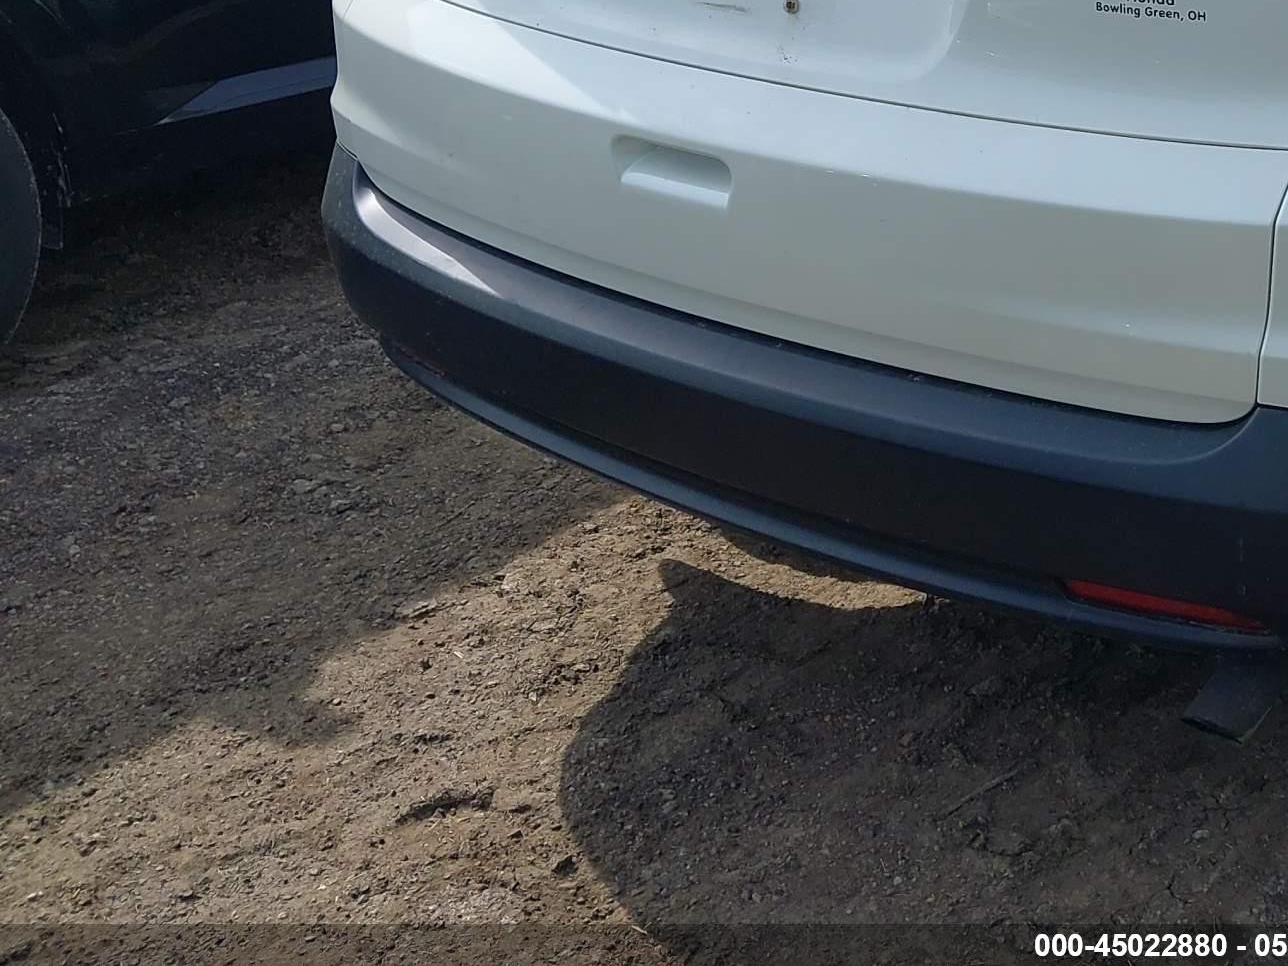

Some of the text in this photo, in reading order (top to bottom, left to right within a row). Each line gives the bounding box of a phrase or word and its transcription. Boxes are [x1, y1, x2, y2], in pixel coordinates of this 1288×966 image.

[1096, 1, 1206, 22] Bowling Green, OH
